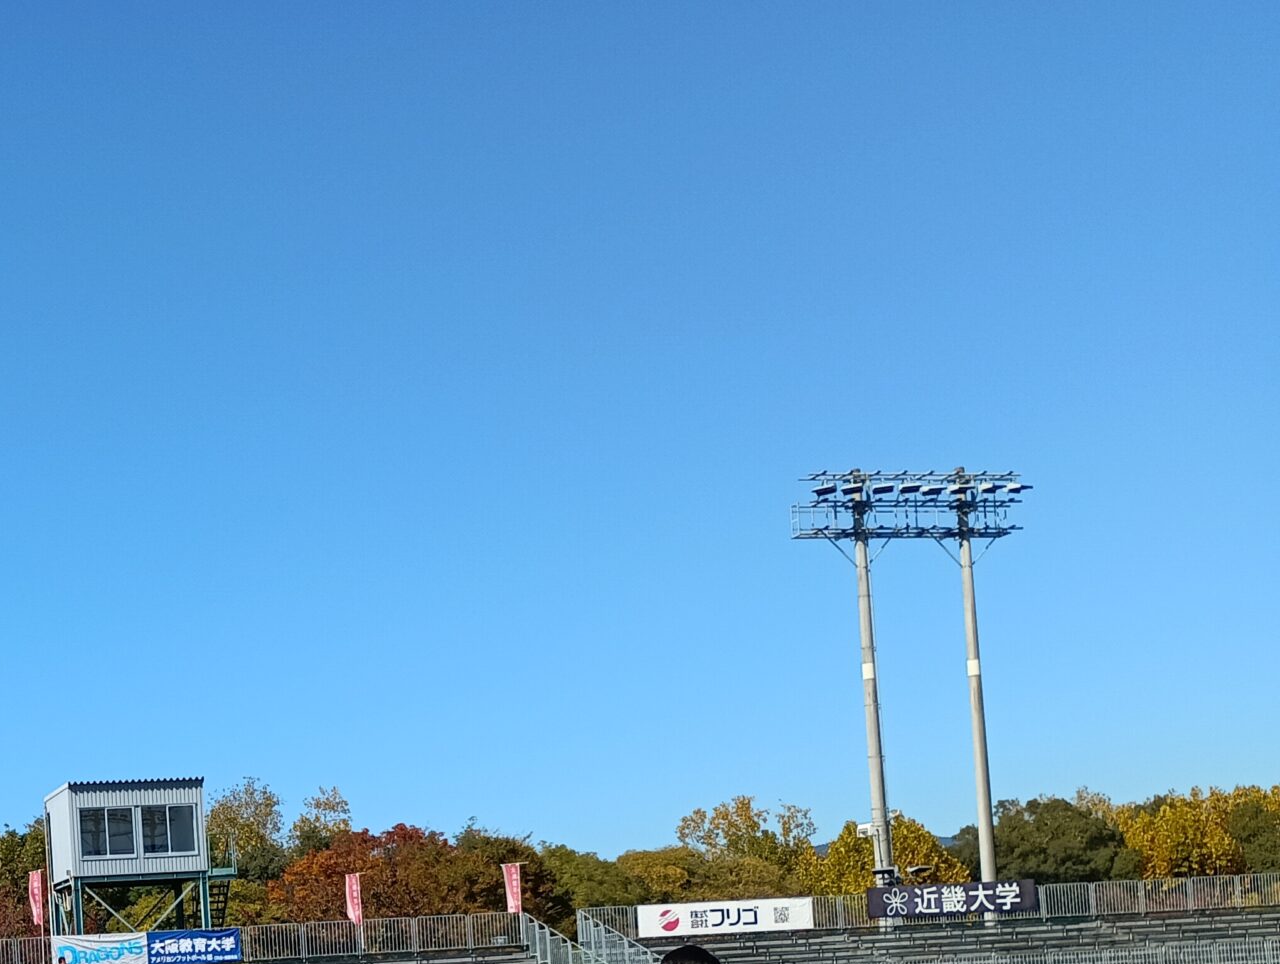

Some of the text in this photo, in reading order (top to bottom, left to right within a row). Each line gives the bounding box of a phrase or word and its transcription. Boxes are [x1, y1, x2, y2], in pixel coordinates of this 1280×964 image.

[914, 883, 1021, 915] 近畿大学
[709, 906, 759, 927] フリゴ
[150, 936, 236, 955] 大阪教育大学
